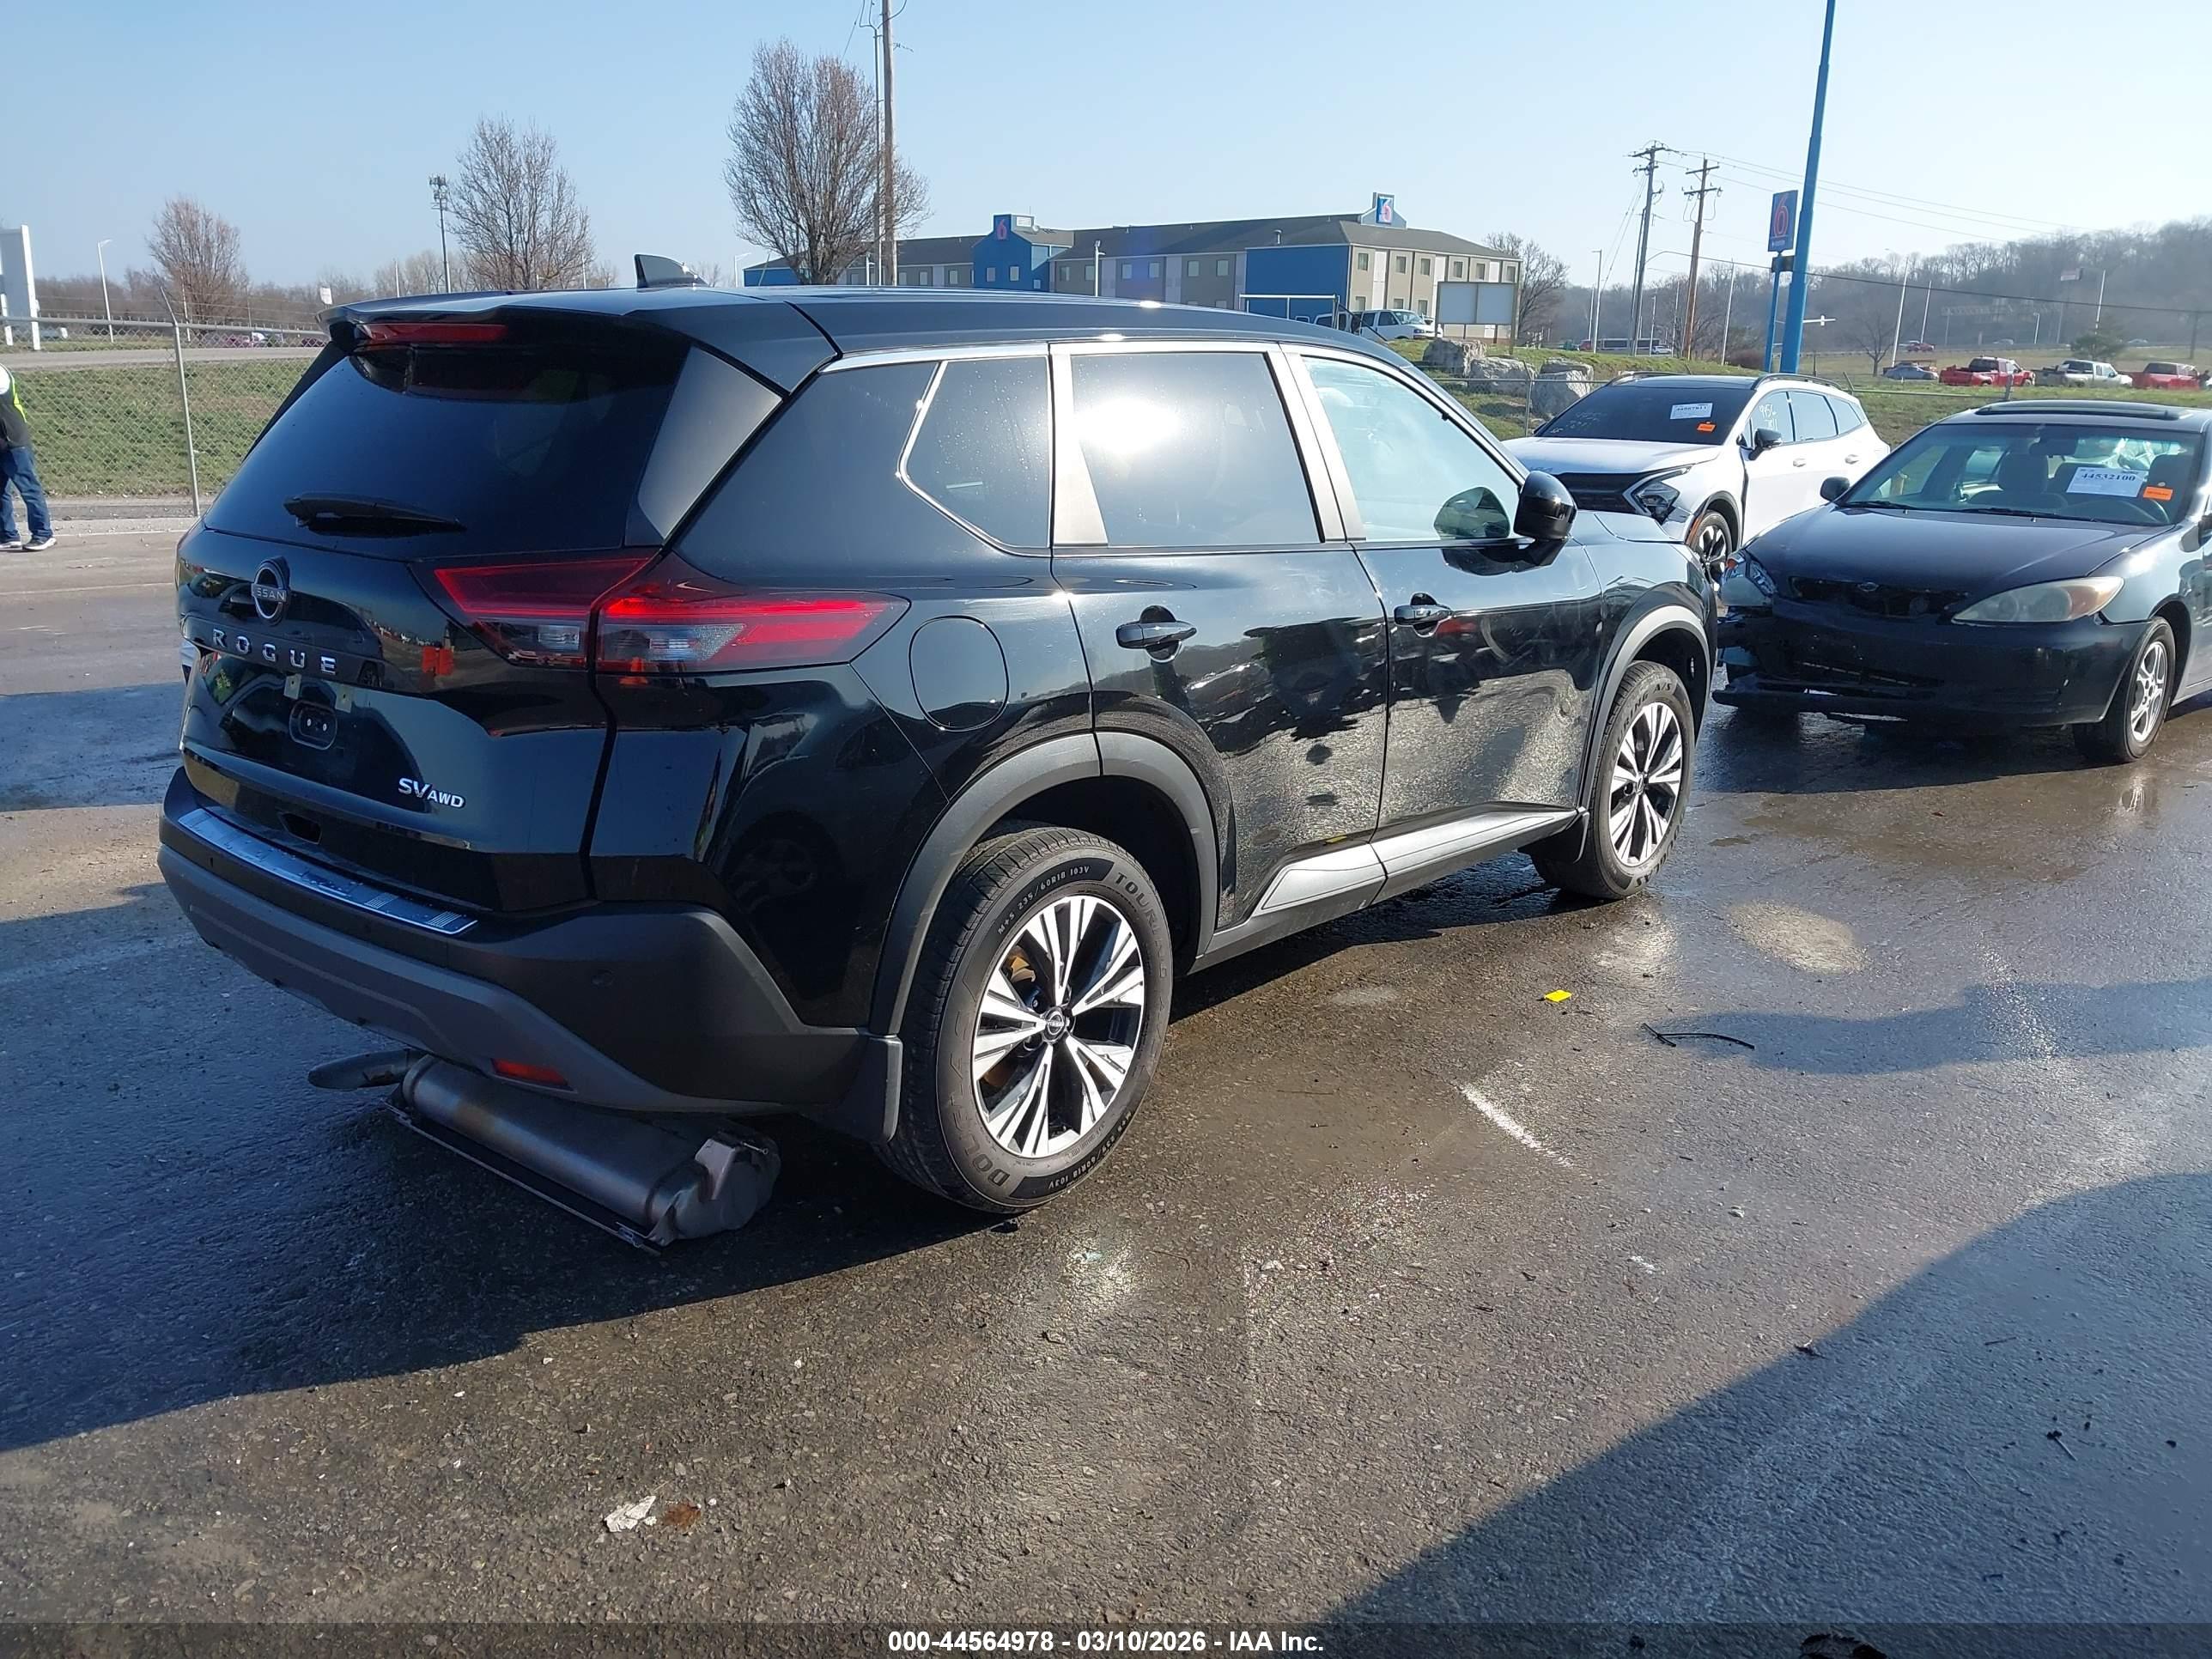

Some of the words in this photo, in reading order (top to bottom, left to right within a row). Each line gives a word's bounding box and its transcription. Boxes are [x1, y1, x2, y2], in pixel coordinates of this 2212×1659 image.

[1773, 191, 1790, 238] 6
[996, 218, 1007, 240] 6
[2081, 473, 2136, 482] 44532100
[254, 586, 287, 601] SSAN
[213, 629, 337, 676] ROGUE
[1653, 683, 1671, 694] A/S
[998, 913, 1015, 935] M+S
[1017, 871, 1066, 910] 235/60R18
[1070, 866, 1091, 877] 103V
